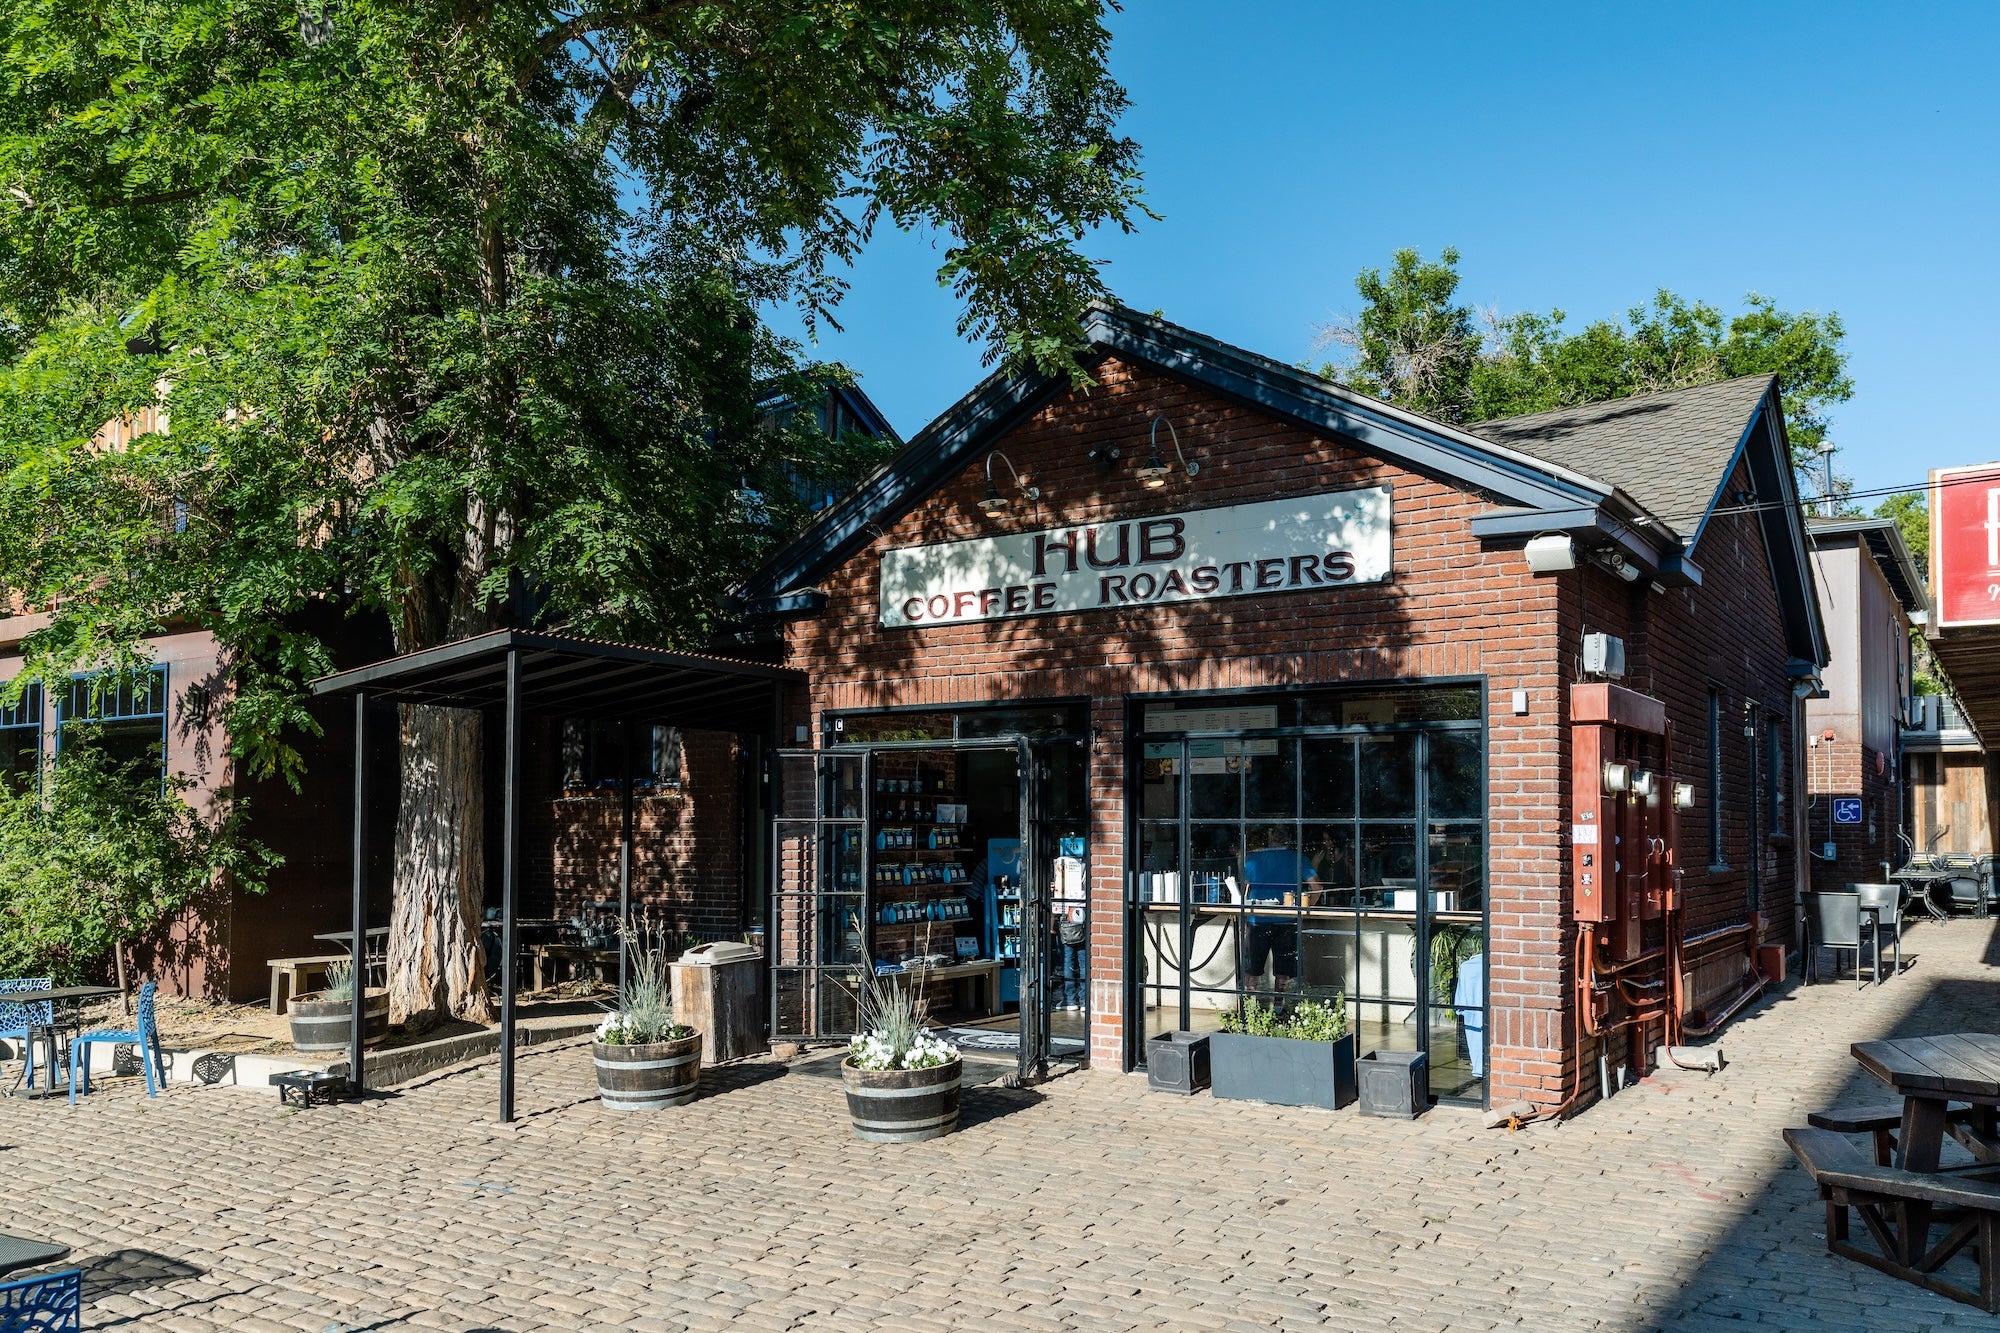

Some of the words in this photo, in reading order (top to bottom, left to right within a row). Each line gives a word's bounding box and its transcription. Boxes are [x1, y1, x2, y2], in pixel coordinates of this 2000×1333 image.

[1032, 517, 1186, 578] HUB
[903, 582, 1058, 621] COFFEE
[1098, 551, 1356, 605] ROASTERS
